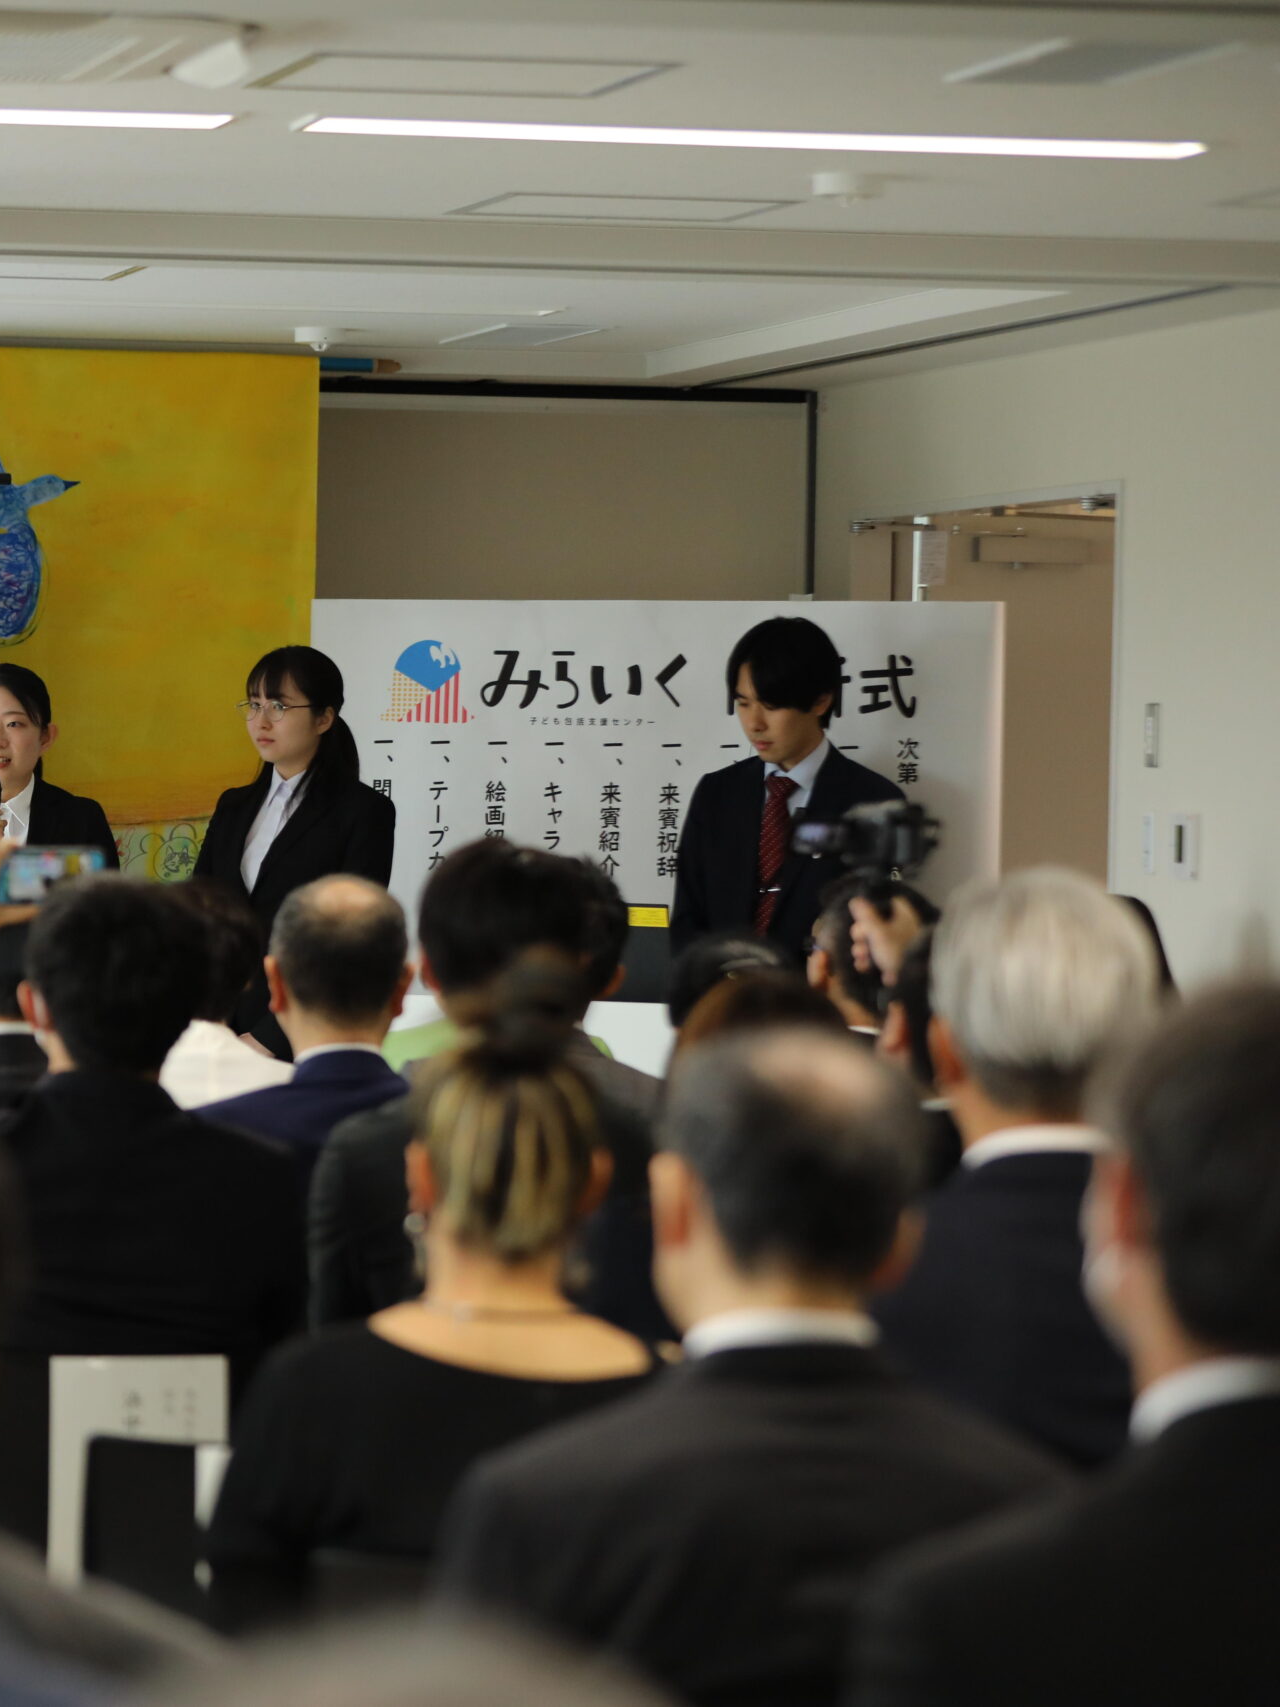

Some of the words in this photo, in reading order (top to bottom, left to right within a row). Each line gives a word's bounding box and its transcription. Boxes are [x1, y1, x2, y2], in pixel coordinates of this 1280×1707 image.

[480, 650, 687, 709] みらいく
[529, 717, 656, 726] 子ども包括支援センター
[897, 738, 920, 784] 次第
